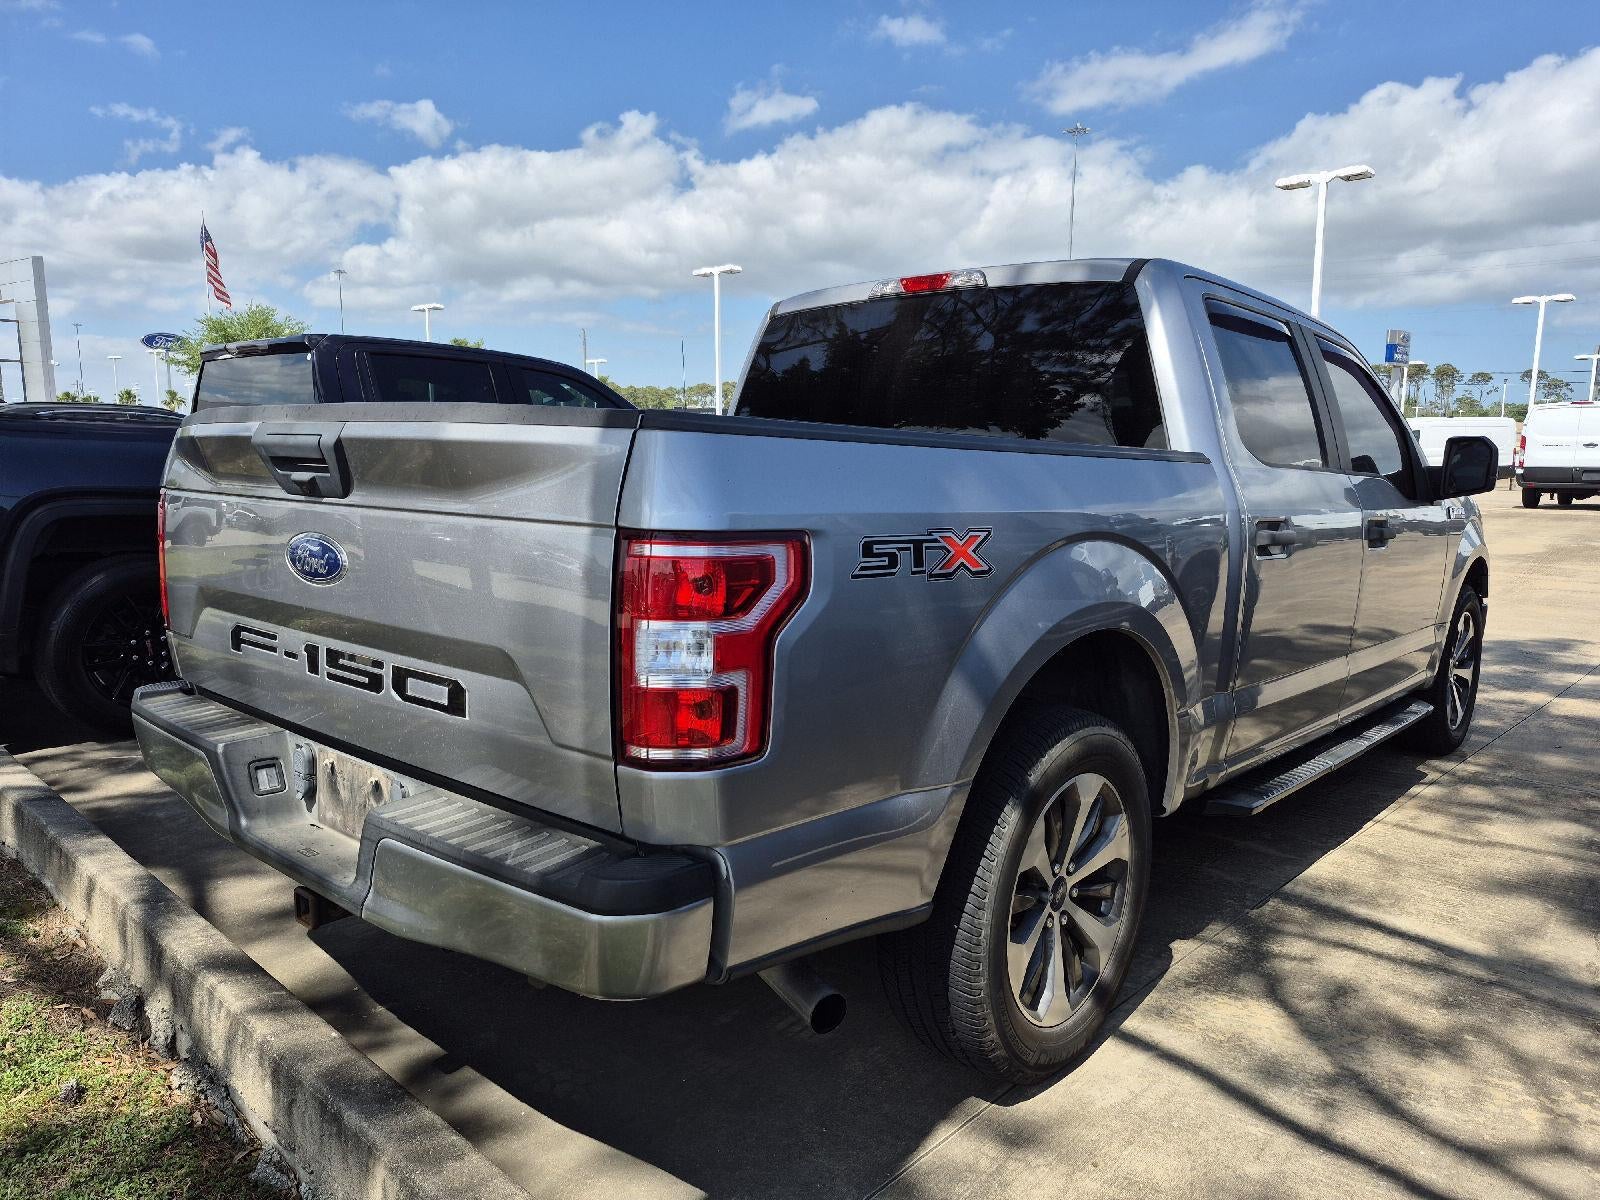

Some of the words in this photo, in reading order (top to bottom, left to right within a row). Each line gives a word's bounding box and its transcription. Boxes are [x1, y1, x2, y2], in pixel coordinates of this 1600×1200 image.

[295, 542, 330, 575] Ford
[850, 527, 996, 582] STX
[230, 622, 469, 720] F-150
